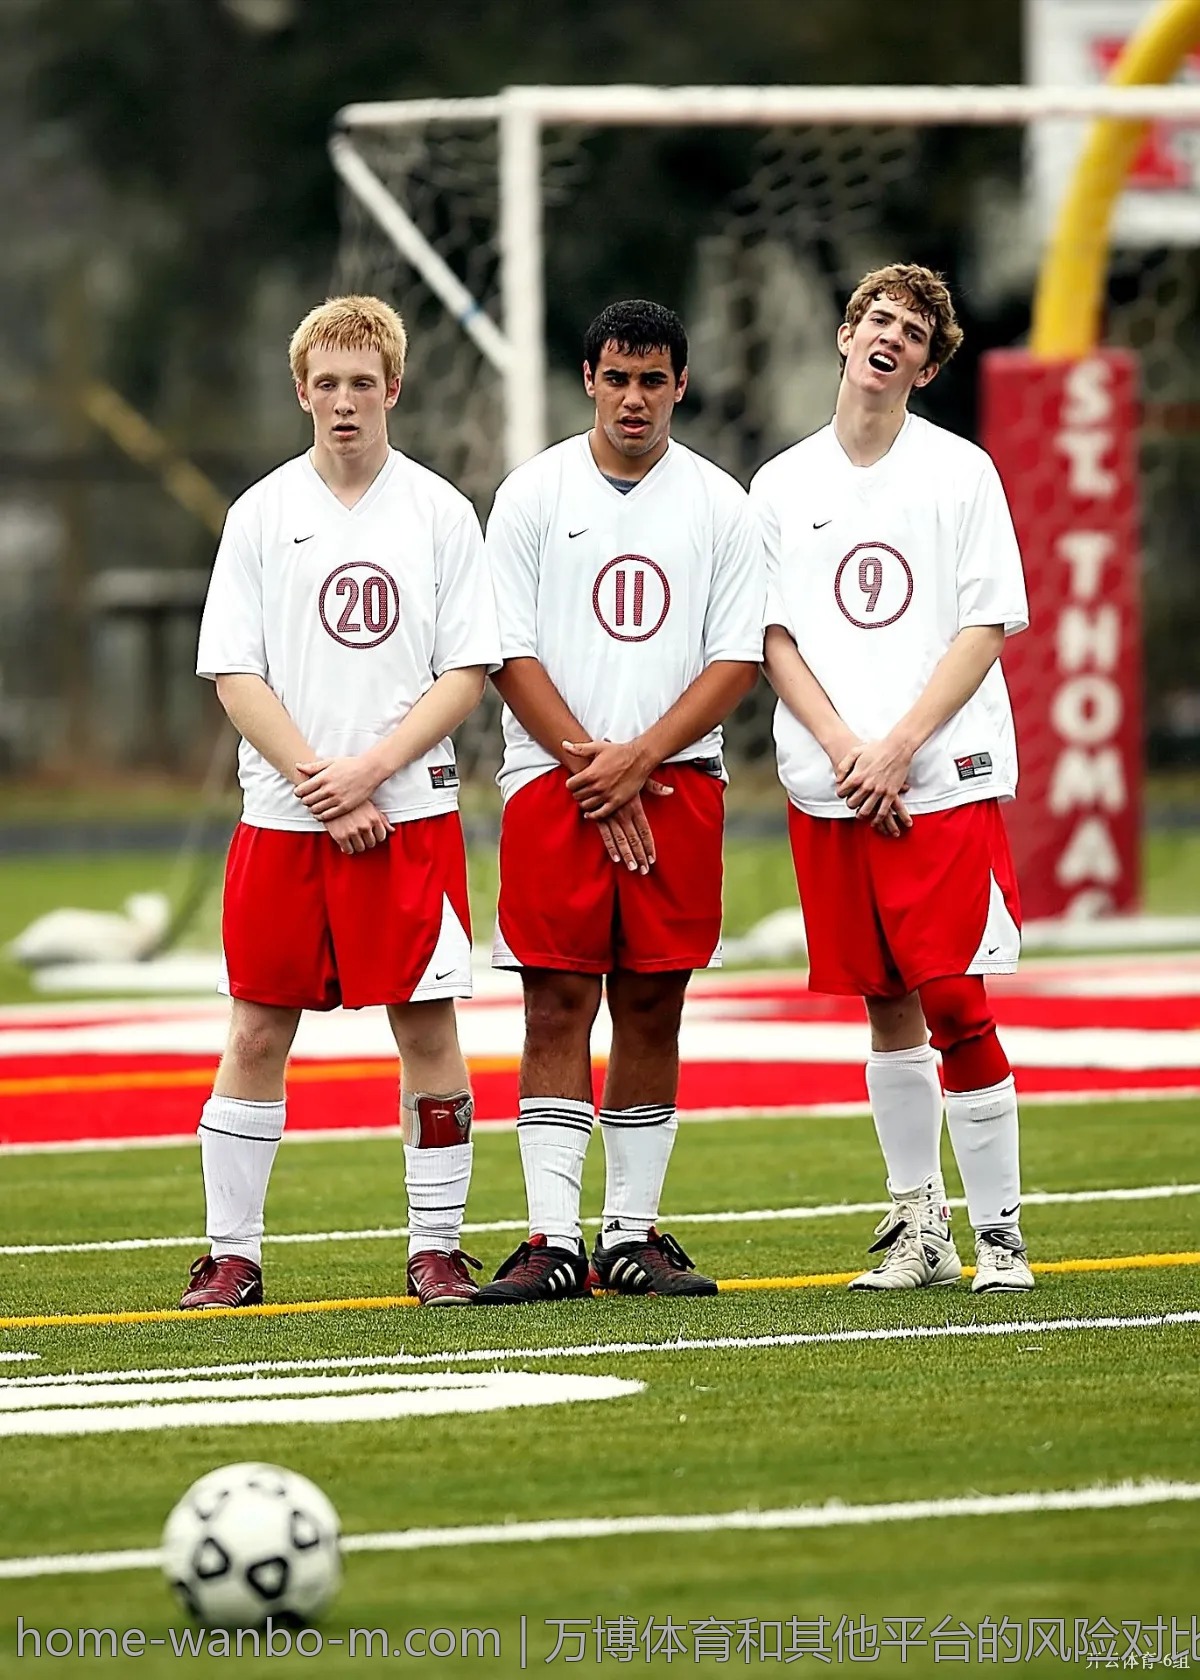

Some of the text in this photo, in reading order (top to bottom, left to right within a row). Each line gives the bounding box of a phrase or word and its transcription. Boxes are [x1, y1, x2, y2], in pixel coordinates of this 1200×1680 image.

[336, 576, 388, 633] 20
[616, 570, 644, 626] 11
[858, 556, 883, 612] 9
